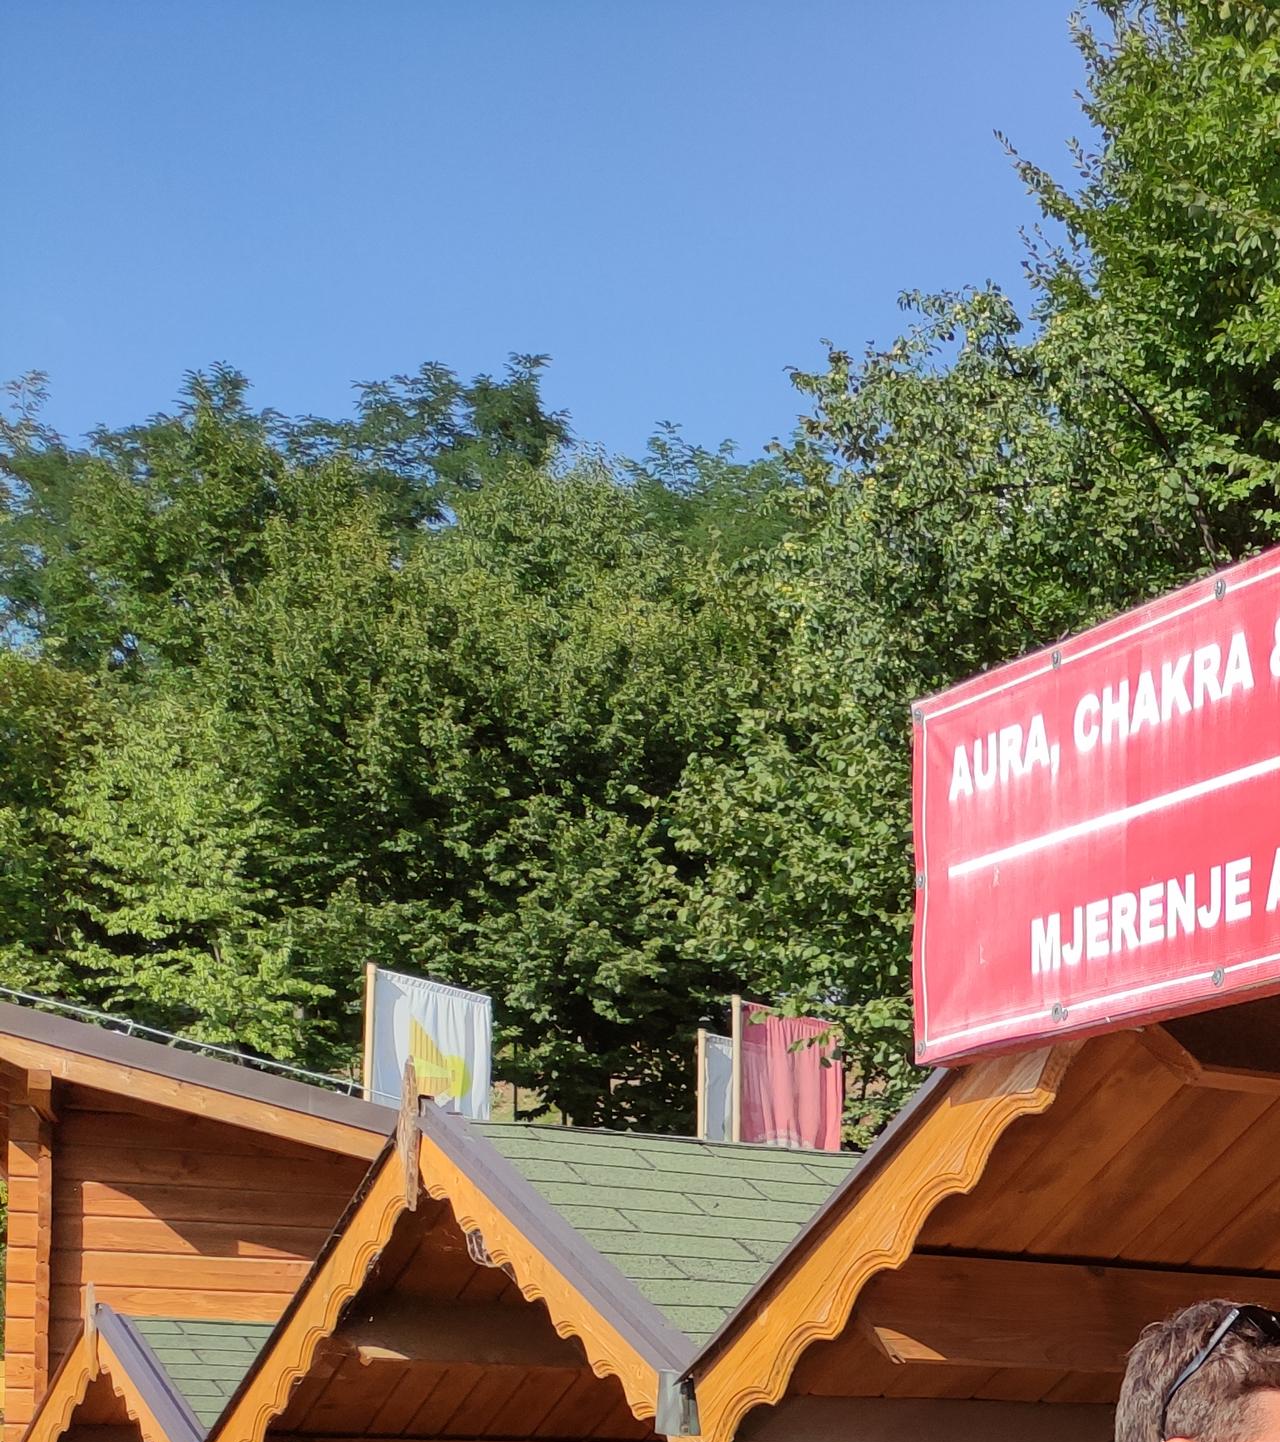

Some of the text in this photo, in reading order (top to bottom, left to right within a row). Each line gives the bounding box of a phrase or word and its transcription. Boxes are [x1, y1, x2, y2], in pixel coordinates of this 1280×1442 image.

[949, 713, 1060, 800] AURA,
[1074, 632, 1254, 753] CHAKRA
[1031, 857, 1251, 975] MJERENJE
